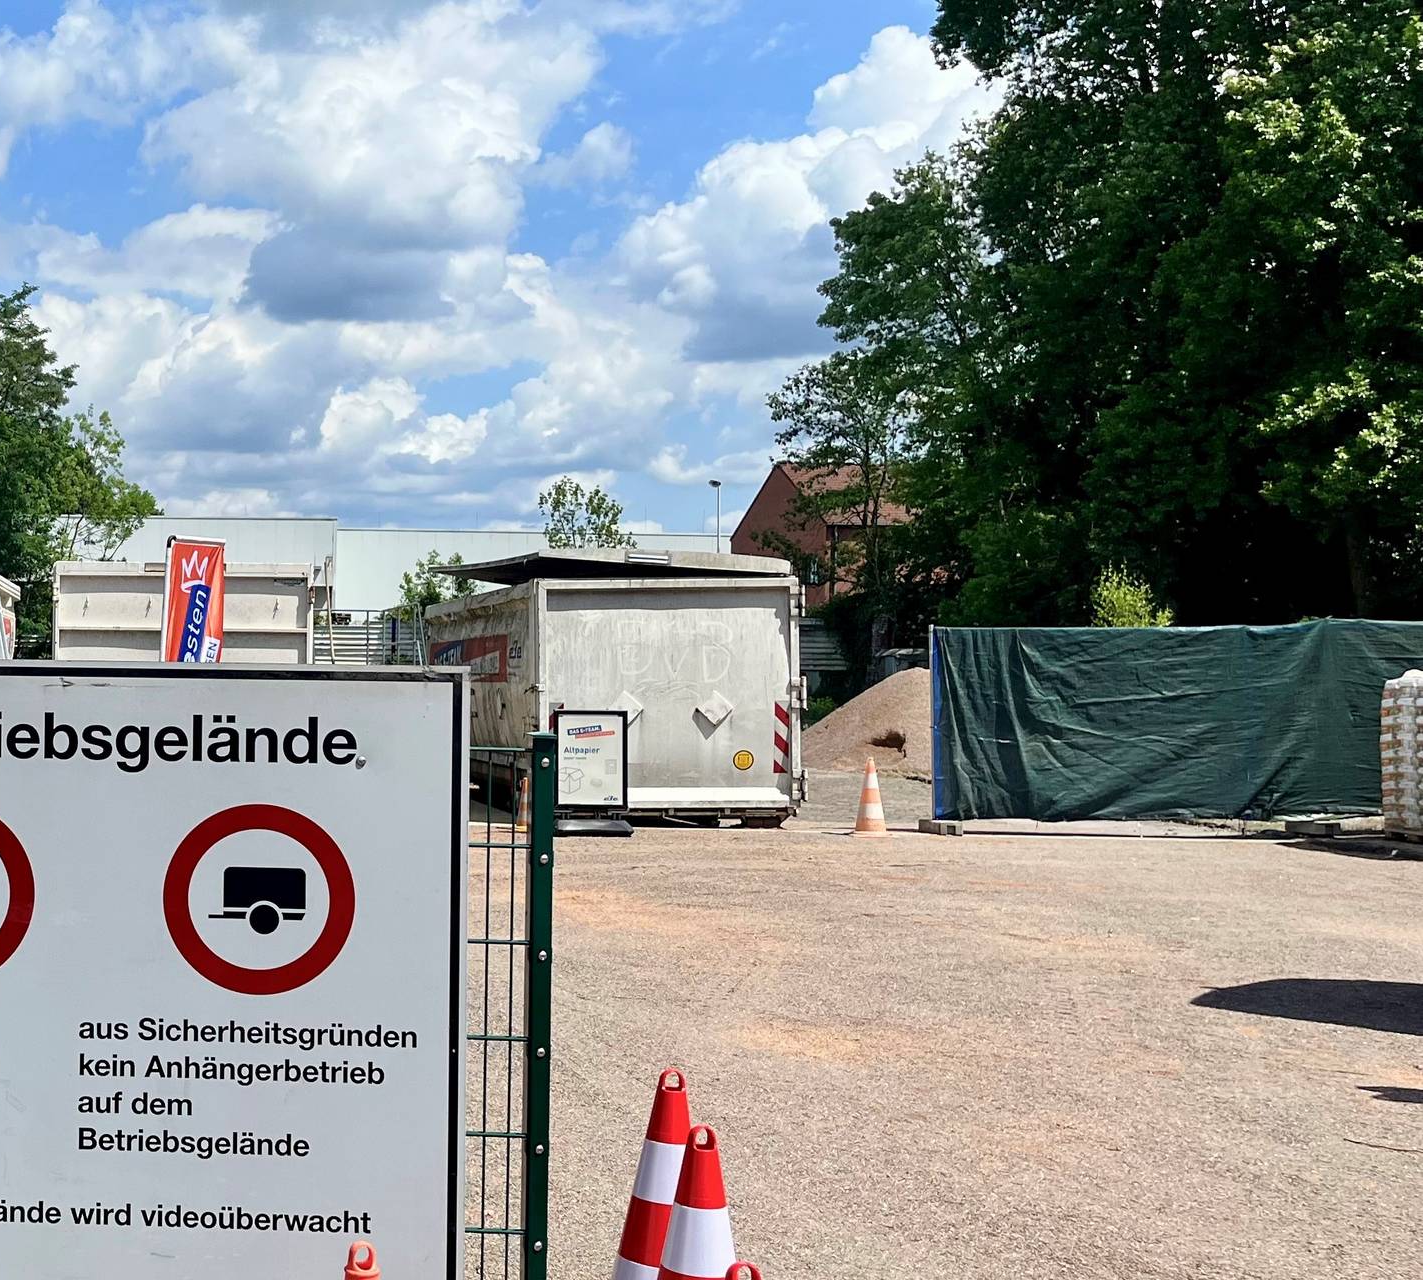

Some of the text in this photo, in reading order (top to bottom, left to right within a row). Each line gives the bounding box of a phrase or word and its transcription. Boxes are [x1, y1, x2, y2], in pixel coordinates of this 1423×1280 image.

[563, 746, 600, 755] Altpapier
[78, 1017, 418, 1051] aus Sicherheitsgründen
[79, 1053, 385, 1087] kein Anhängerbetrieb
[77, 1091, 193, 1116] auf dem
[78, 1127, 310, 1160] Betriebsgelände
[70, 1202, 132, 1227] wird
[140, 1204, 372, 1235] videoüberwacht
